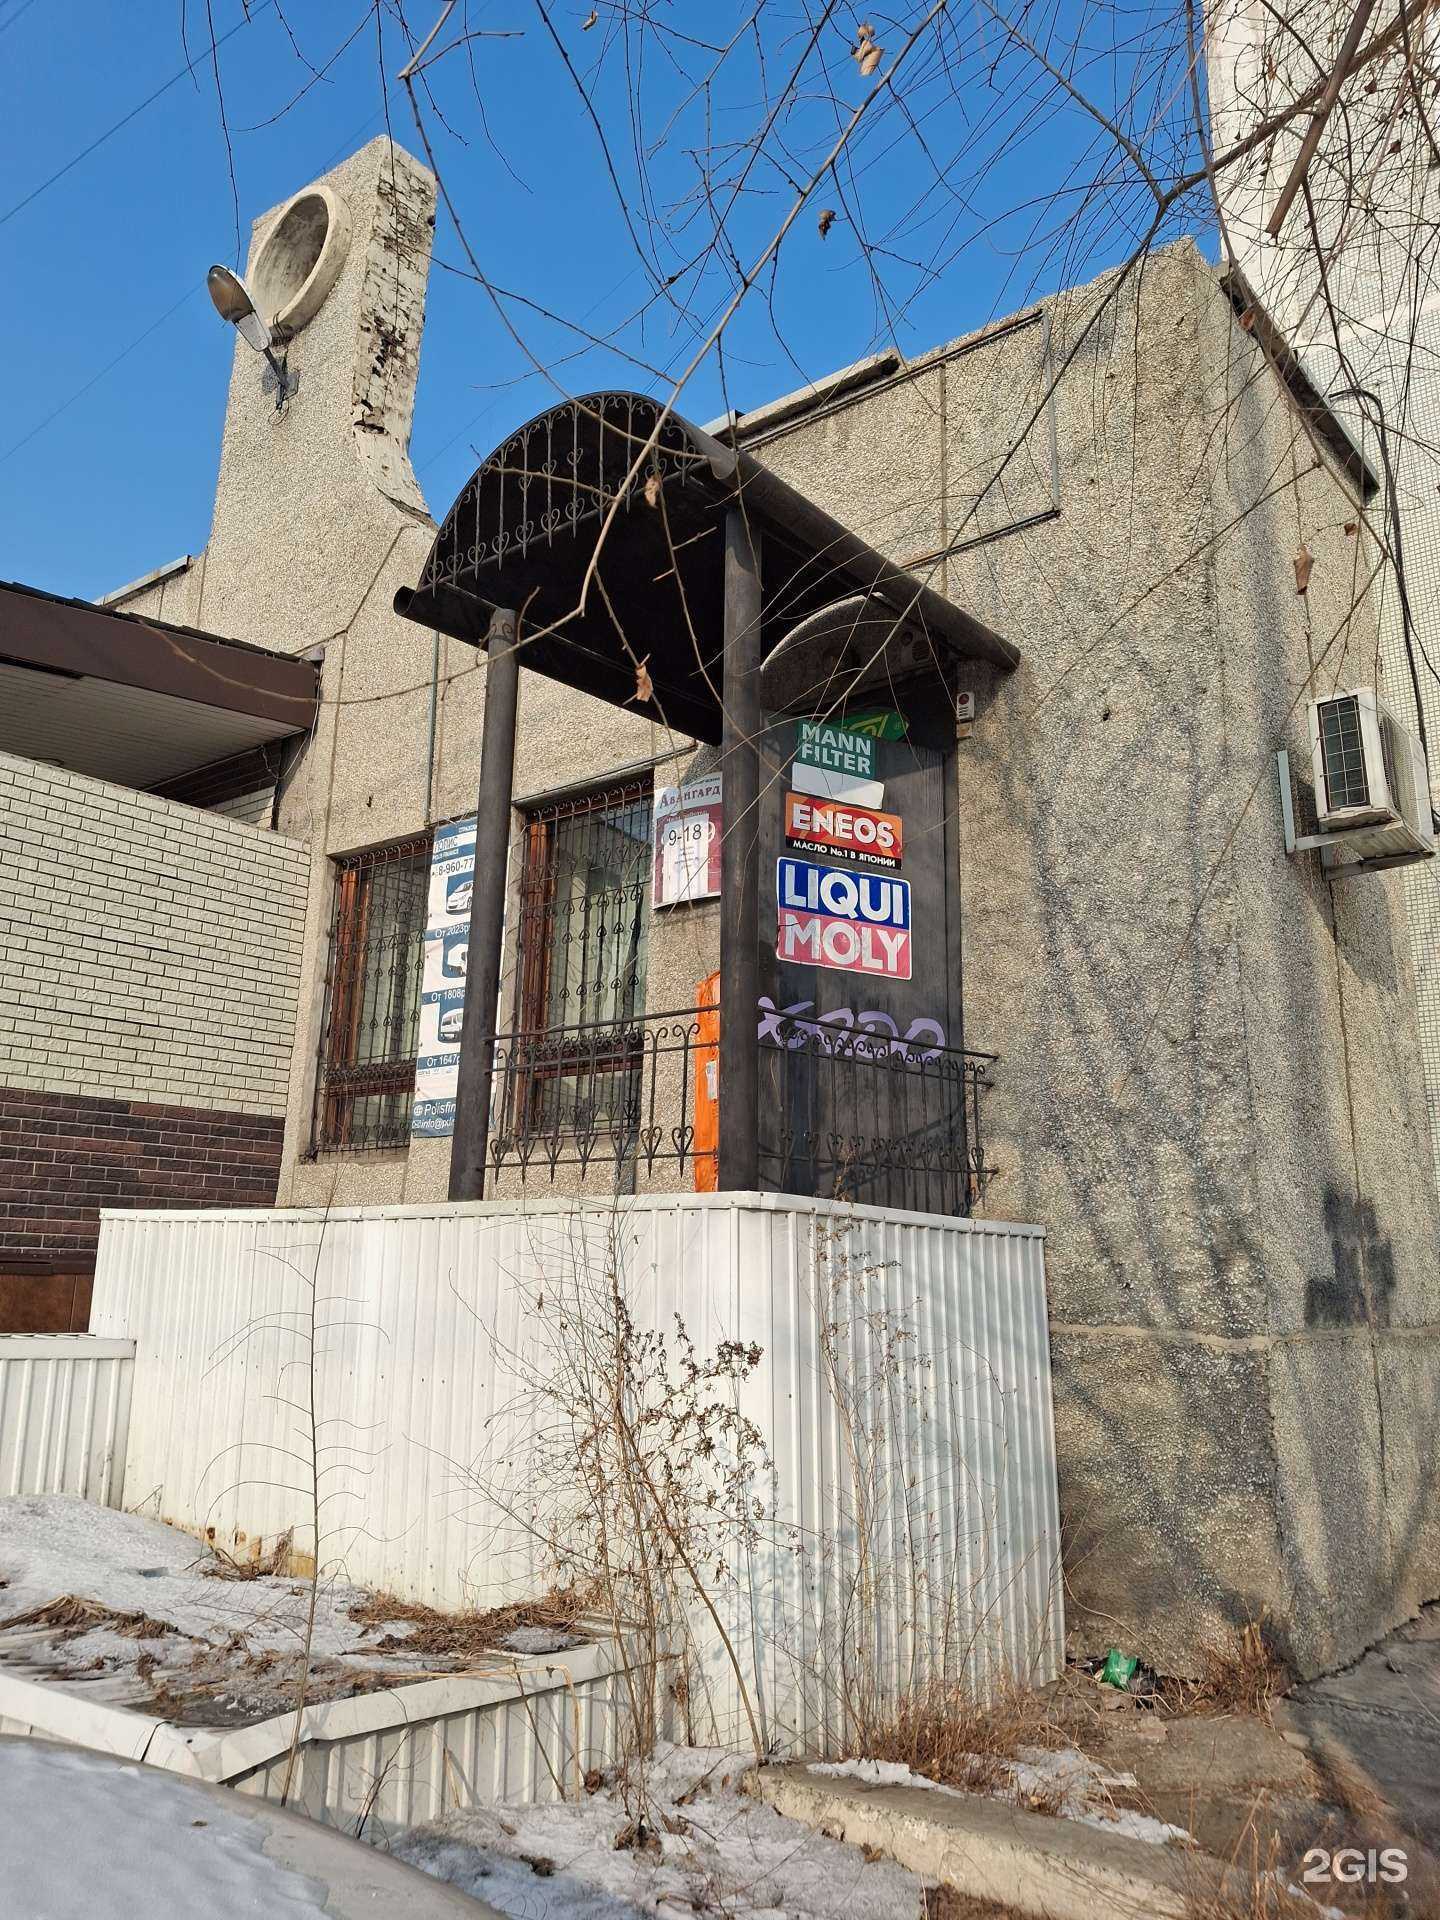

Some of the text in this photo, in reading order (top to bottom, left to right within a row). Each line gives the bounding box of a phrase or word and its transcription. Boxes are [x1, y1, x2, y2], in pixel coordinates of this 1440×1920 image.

[802, 723, 871, 756] MANN
[801, 743, 871, 775] FILTER
[668, 823, 702, 847] 9-18
[792, 803, 895, 848] ENEOS
[793, 840, 828, 853] МАСЛО
[850, 851, 856, 859] В
[859, 853, 896, 868] ЯПОНИИ
[785, 864, 904, 925] LIQUI
[435, 928, 446, 938] От
[784, 913, 908, 972] MOLY
[431, 992, 442, 1002] От
[427, 1056, 438, 1067] От
